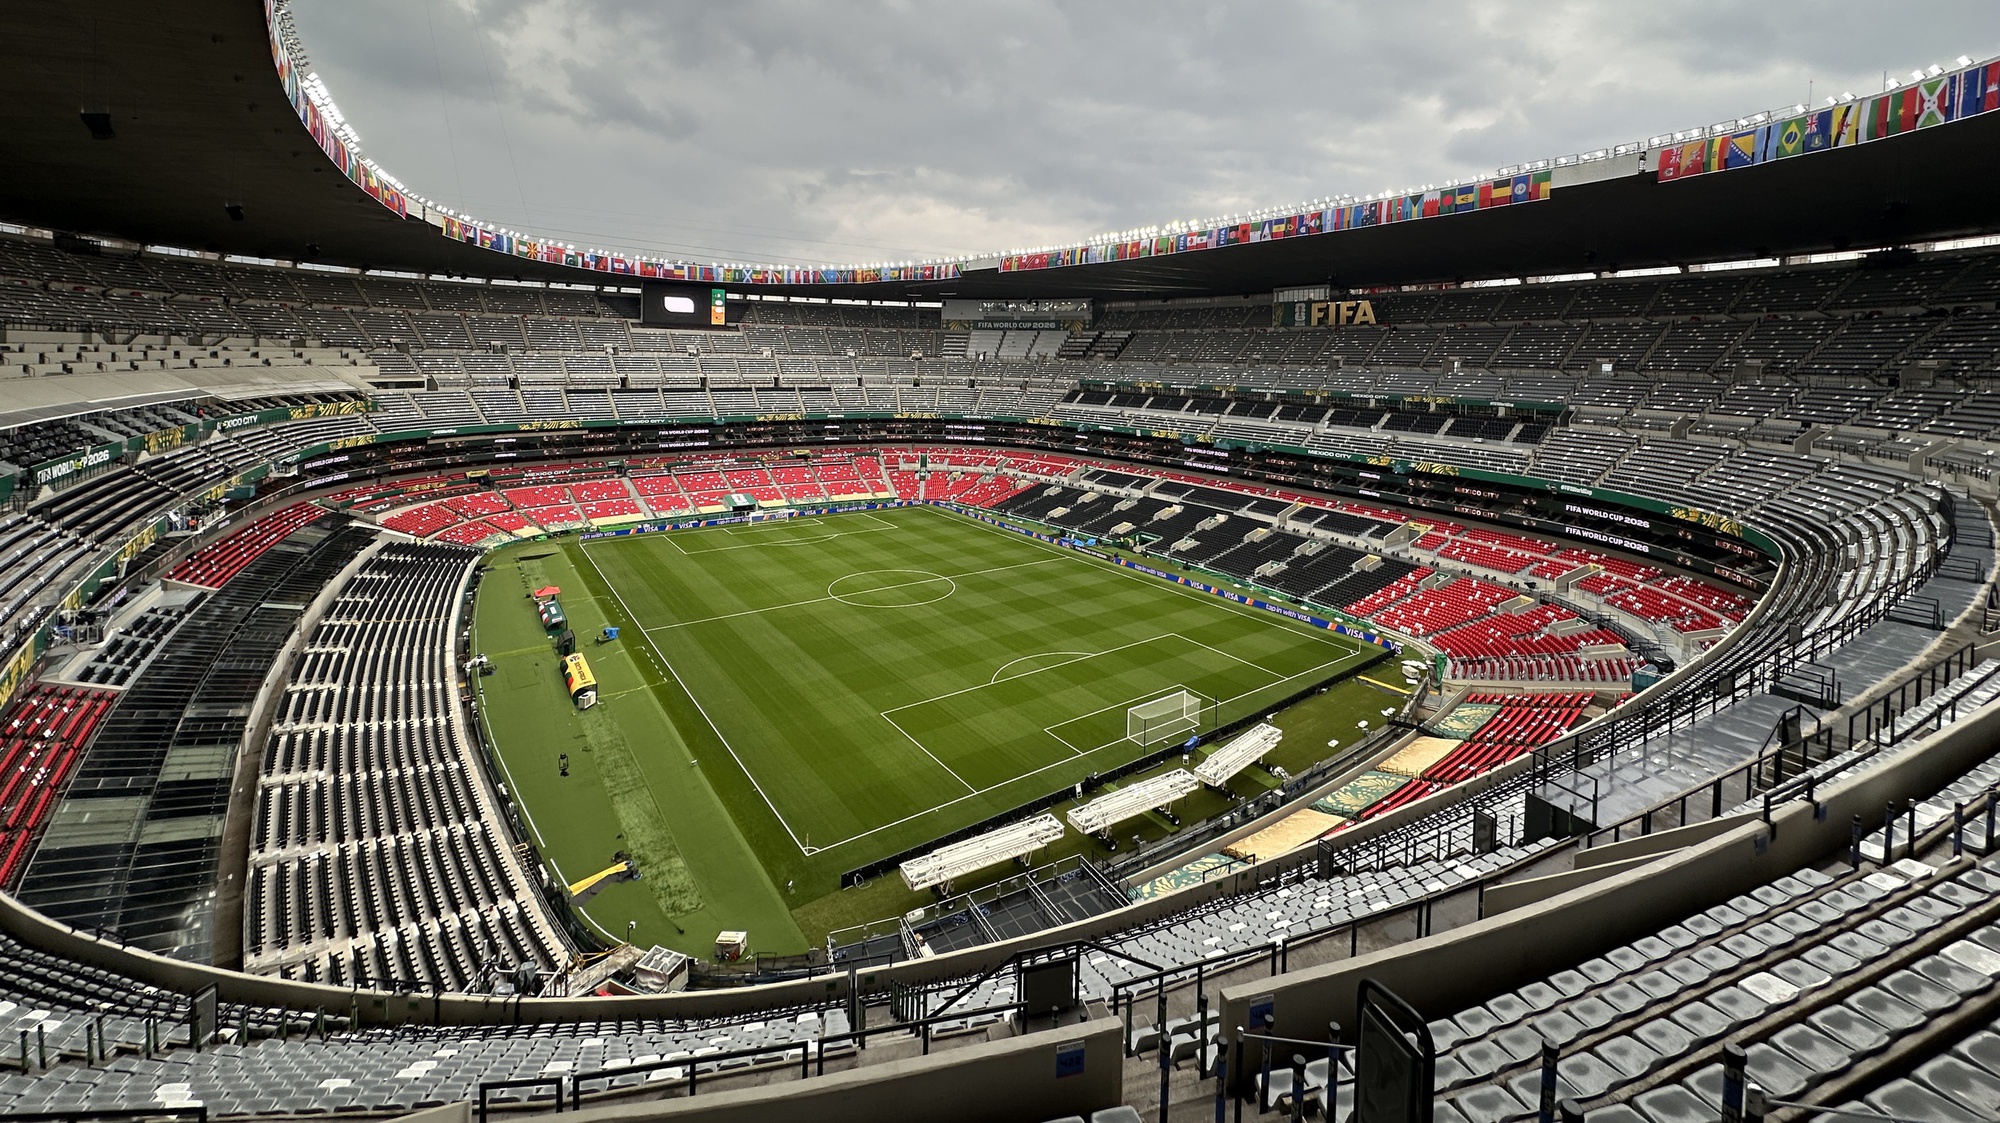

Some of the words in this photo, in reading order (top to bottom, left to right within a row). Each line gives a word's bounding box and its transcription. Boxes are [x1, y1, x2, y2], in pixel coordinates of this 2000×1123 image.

[1311, 300, 1376, 326] FIFA
[217, 418, 242, 430] MXICO
[243, 415, 258, 424] CITY
[88, 449, 109, 466] 2026
[1482, 511, 1500, 519] CITY
[1565, 504, 1582, 513] FIFA
[1582, 507, 1608, 519] WORLD
[1609, 511, 1623, 522] CUP
[1624, 516, 1650, 528] 2026
[1565, 527, 1581, 535] FIFA
[1582, 529, 1608, 541] WORLD
[1609, 536, 1623, 545] CUP
[1623, 540, 1649, 553] 2026
[1715, 539, 1742, 554] MEXICO
[1743, 549, 1758, 559] CITY
[1190, 580, 1204, 591] VISA
[1714, 567, 1742, 582] MEXICO
[1742, 577, 1758, 589] CITY
[1223, 590, 1239, 601] VISA
[1283, 610, 1296, 618] with
[1296, 612, 1311, 623] VISA
[1344, 626, 1364, 640] VISA
